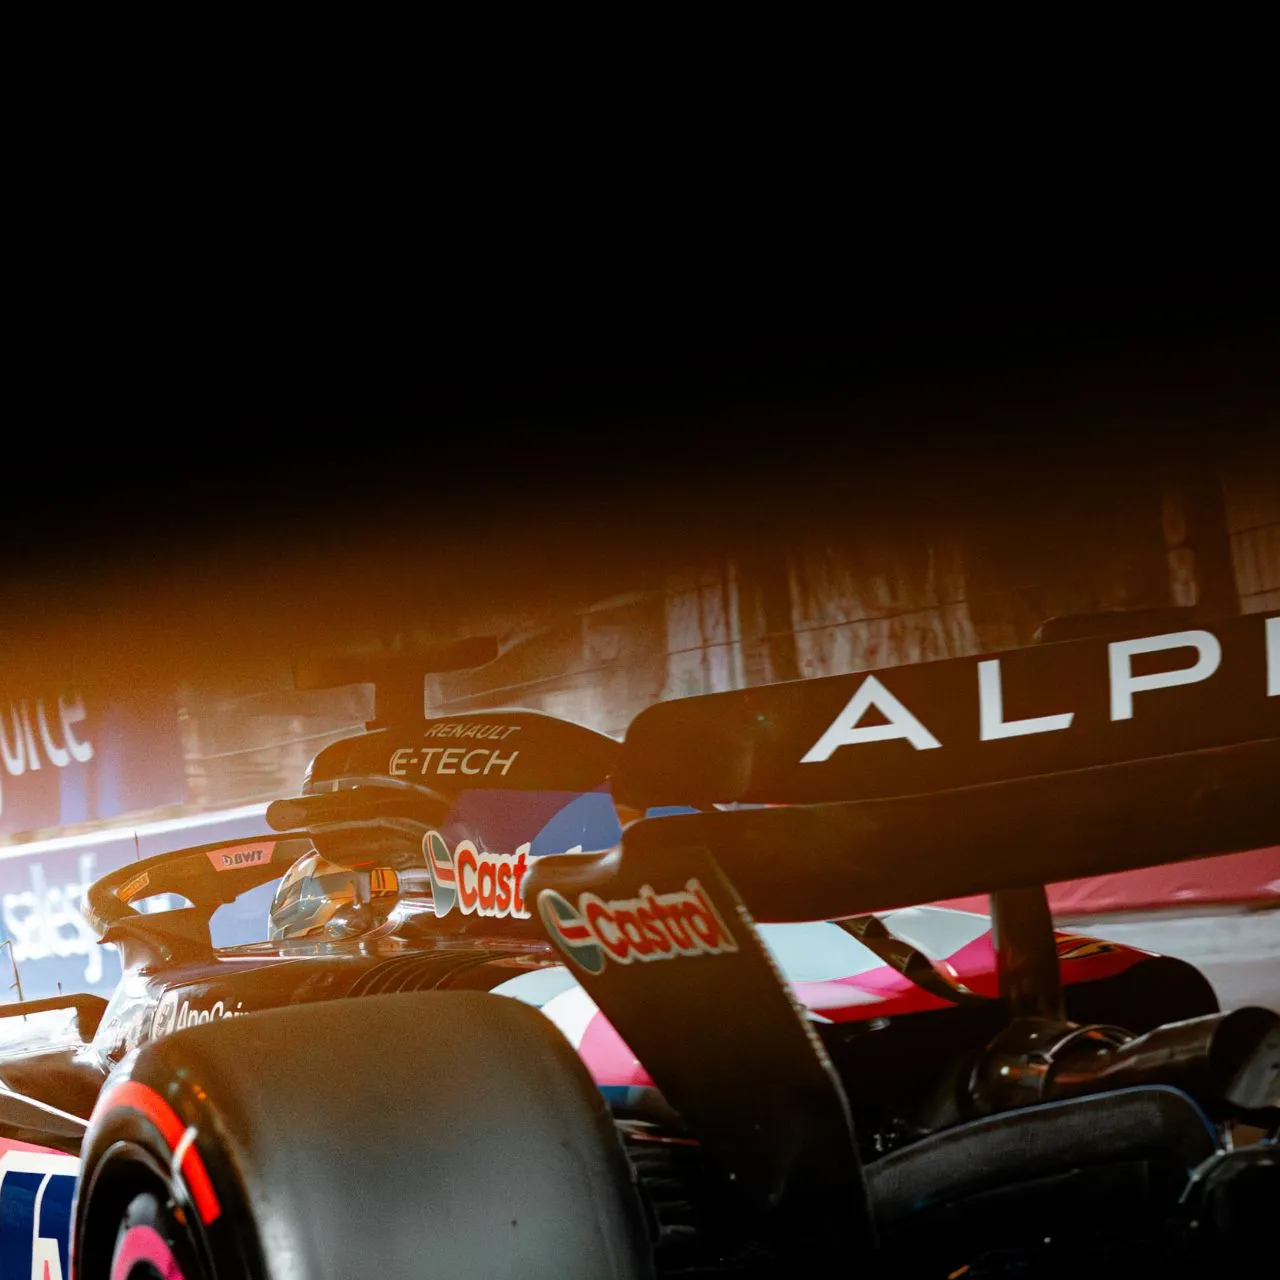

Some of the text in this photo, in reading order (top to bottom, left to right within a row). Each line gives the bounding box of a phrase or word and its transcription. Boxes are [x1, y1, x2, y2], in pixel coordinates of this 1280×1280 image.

[423, 722, 521, 740] RENAULT
[389, 748, 520, 776] E-TECH
[455, 841, 532, 918] Cast
[582, 880, 737, 962] Castrol
